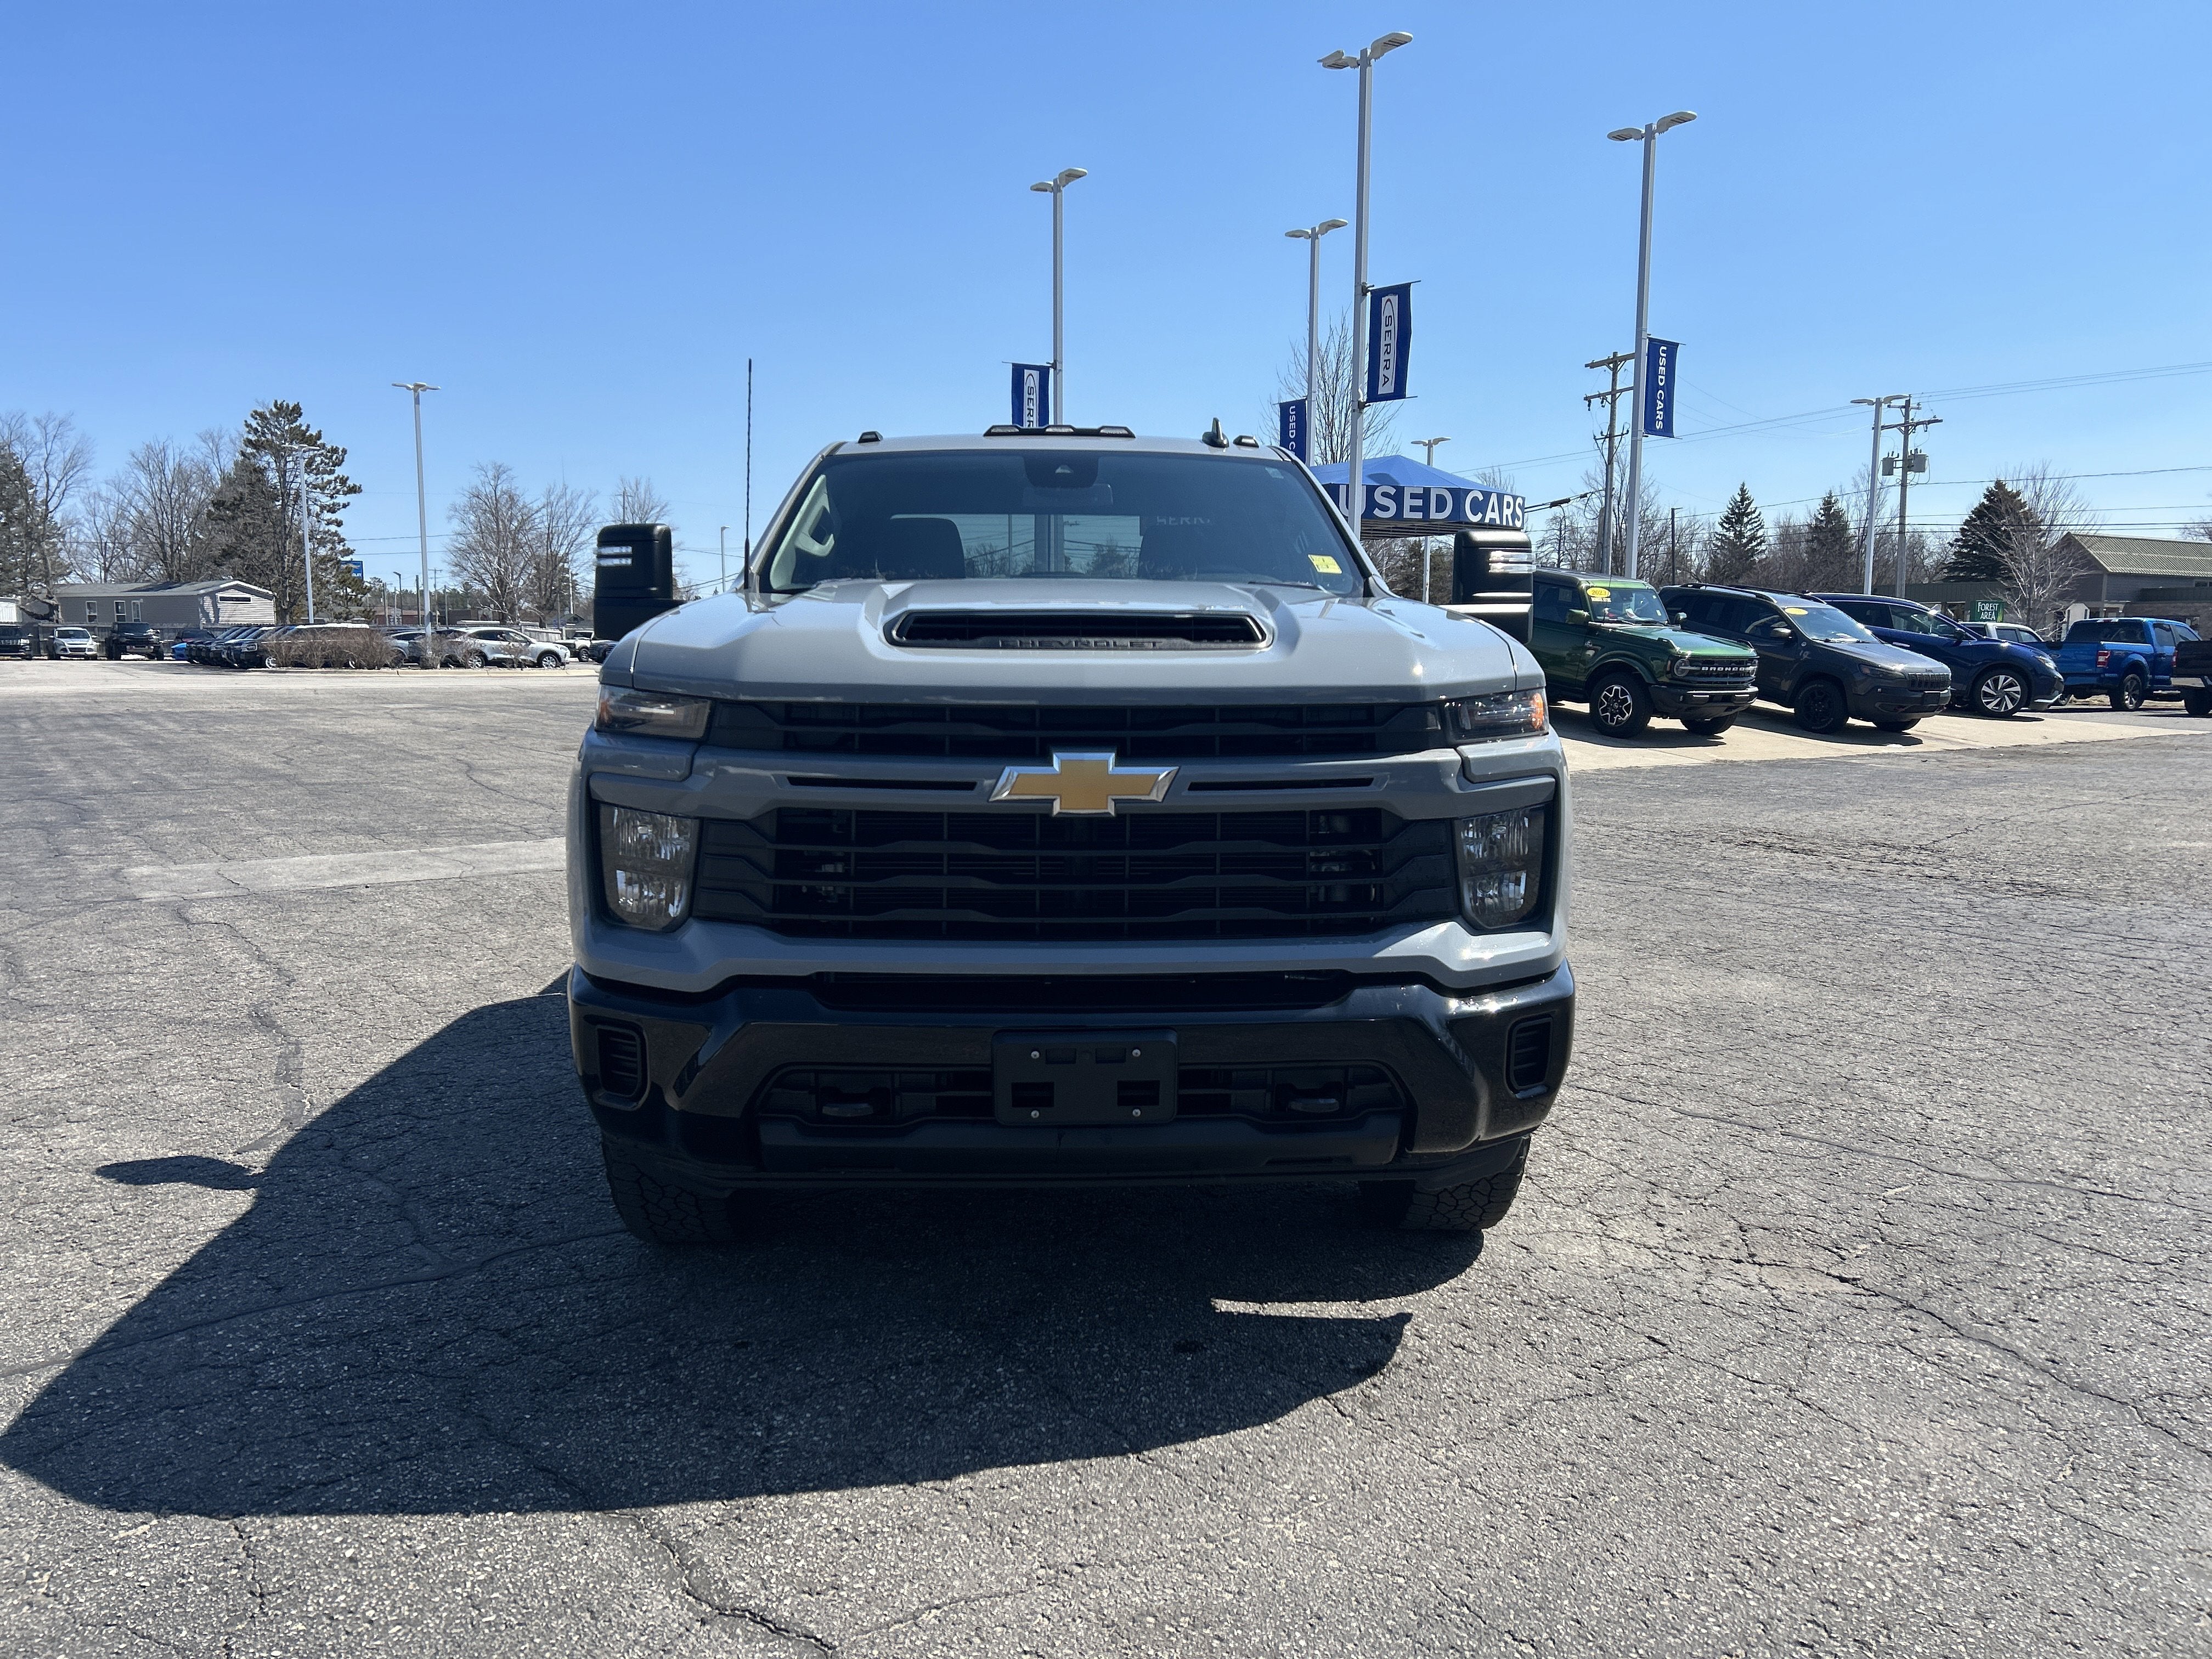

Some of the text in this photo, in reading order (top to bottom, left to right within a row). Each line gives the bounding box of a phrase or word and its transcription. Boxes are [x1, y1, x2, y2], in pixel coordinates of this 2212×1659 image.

[1382, 315, 1392, 387] SERRA
[1656, 346, 1667, 430] USED CARS
[1339, 484, 1523, 528] USED CARS
[1977, 602, 1999, 612] FOREST
[1980, 611, 1995, 620] AREA
[998, 639, 1163, 648] CHEVROLET
